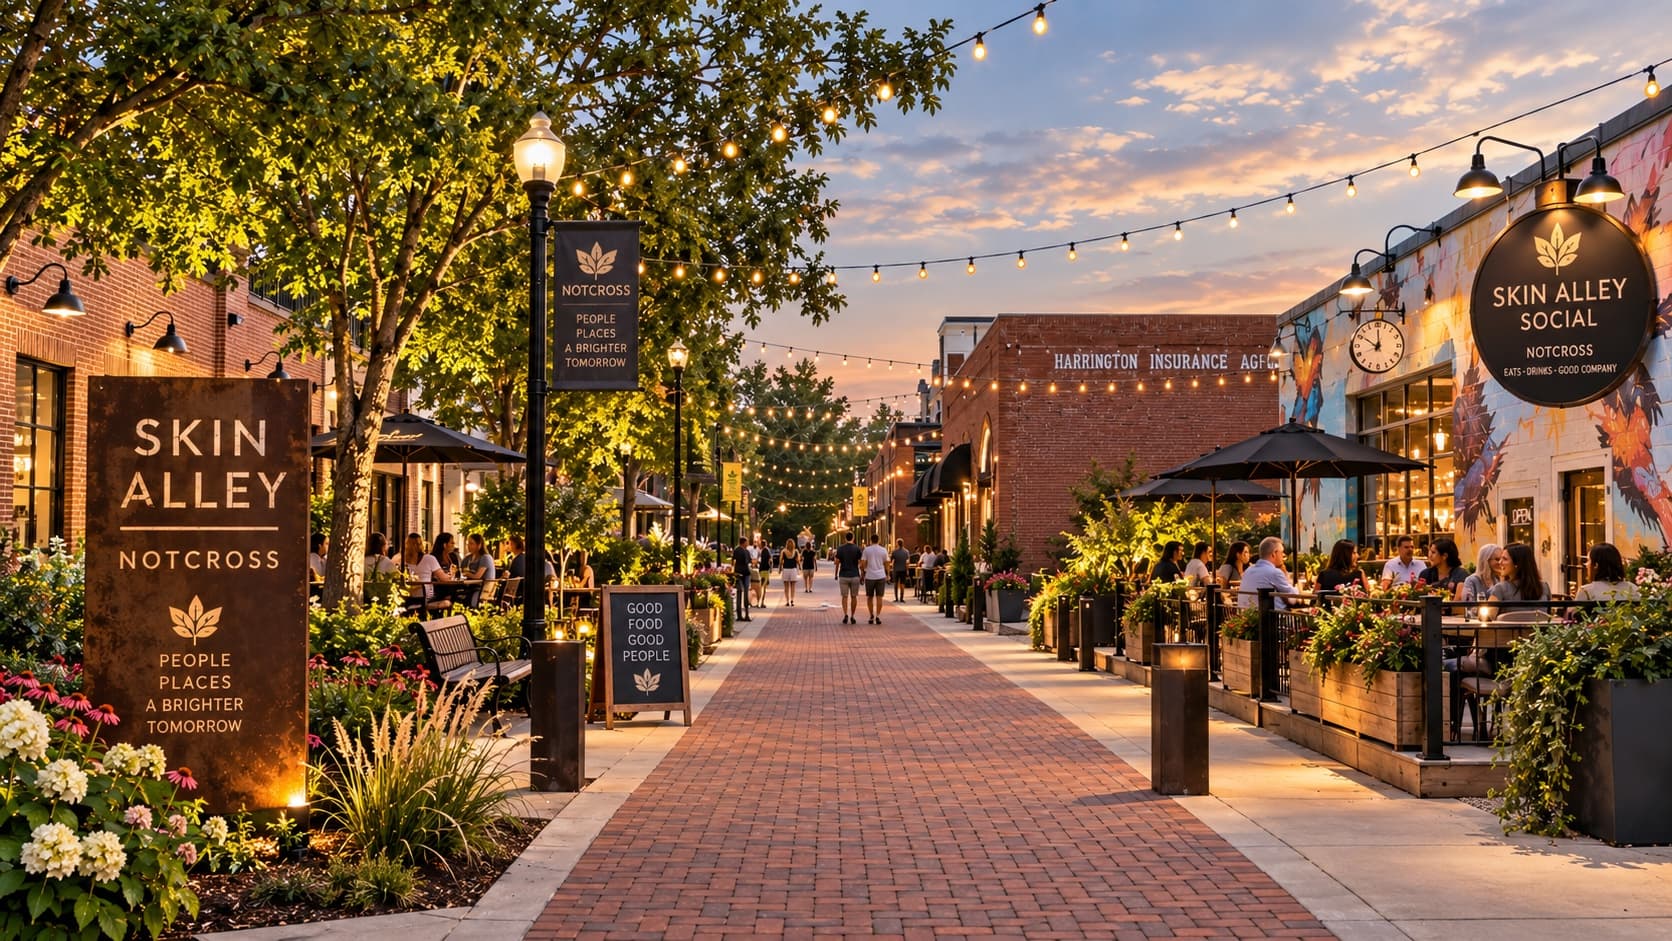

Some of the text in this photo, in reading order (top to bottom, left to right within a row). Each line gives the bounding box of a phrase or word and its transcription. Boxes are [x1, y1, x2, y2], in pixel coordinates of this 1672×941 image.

[563, 285, 630, 296] NOTCROSS
[1494, 278, 1626, 307] SKIN ALLEY
[577, 314, 615, 324] PEOPLE
[1521, 309, 1597, 330] SOCIAL
[577, 329, 615, 338] PLACES
[565, 343, 626, 353] A BRIGHTER
[1527, 344, 1593, 358] NOTCROSS
[566, 358, 626, 367] TOMORROW
[1055, 354, 1137, 369] HARRINGTON
[1151, 354, 1227, 369] INSURANCE
[1504, 368, 1521, 376] EATS
[1527, 367, 1552, 375] DRINKS
[1557, 365, 1579, 375] GOOD
[135, 419, 265, 456] SKIN
[121, 472, 286, 508] ALLEY
[120, 551, 278, 569] NOTCROSS
[627, 603, 662, 614] GOOD
[629, 618, 662, 629] FOOD
[628, 634, 664, 645] GOOD
[160, 654, 230, 667] PEOPLE
[624, 650, 670, 661] PEOPLE
[160, 675, 230, 689] PLACES
[146, 698, 243, 712] A BRIGHTER
[147, 720, 242, 733] TOMORROW
